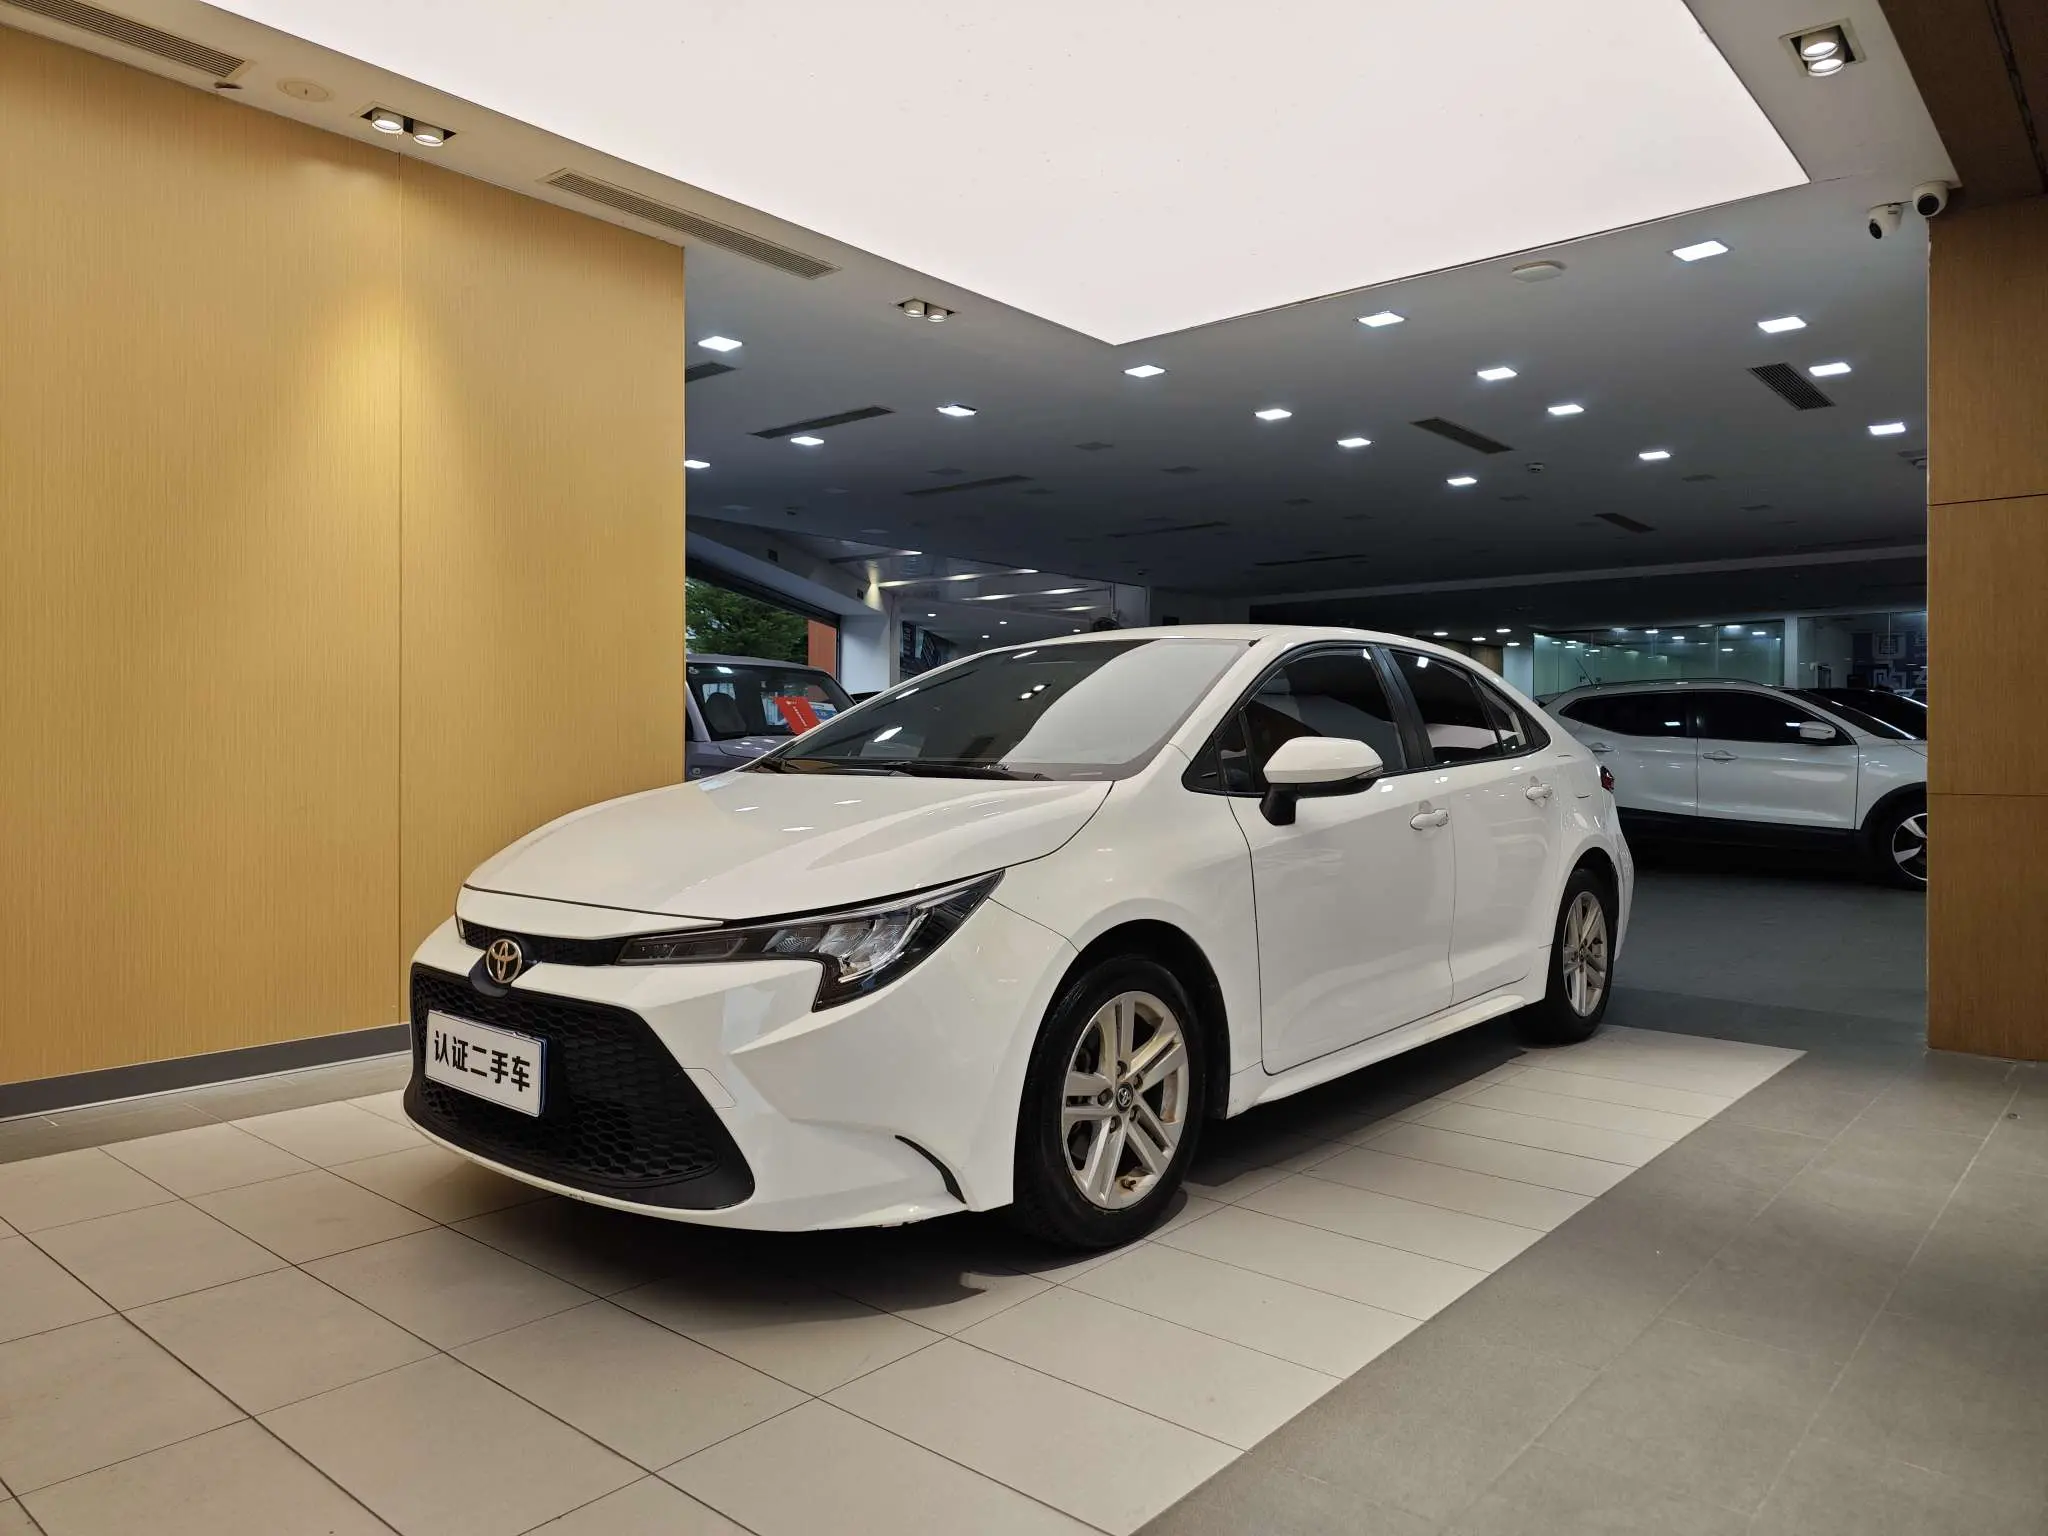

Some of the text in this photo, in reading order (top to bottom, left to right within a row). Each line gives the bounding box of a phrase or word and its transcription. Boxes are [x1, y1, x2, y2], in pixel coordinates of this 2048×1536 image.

[434, 1030, 531, 1092] 认证二手车
